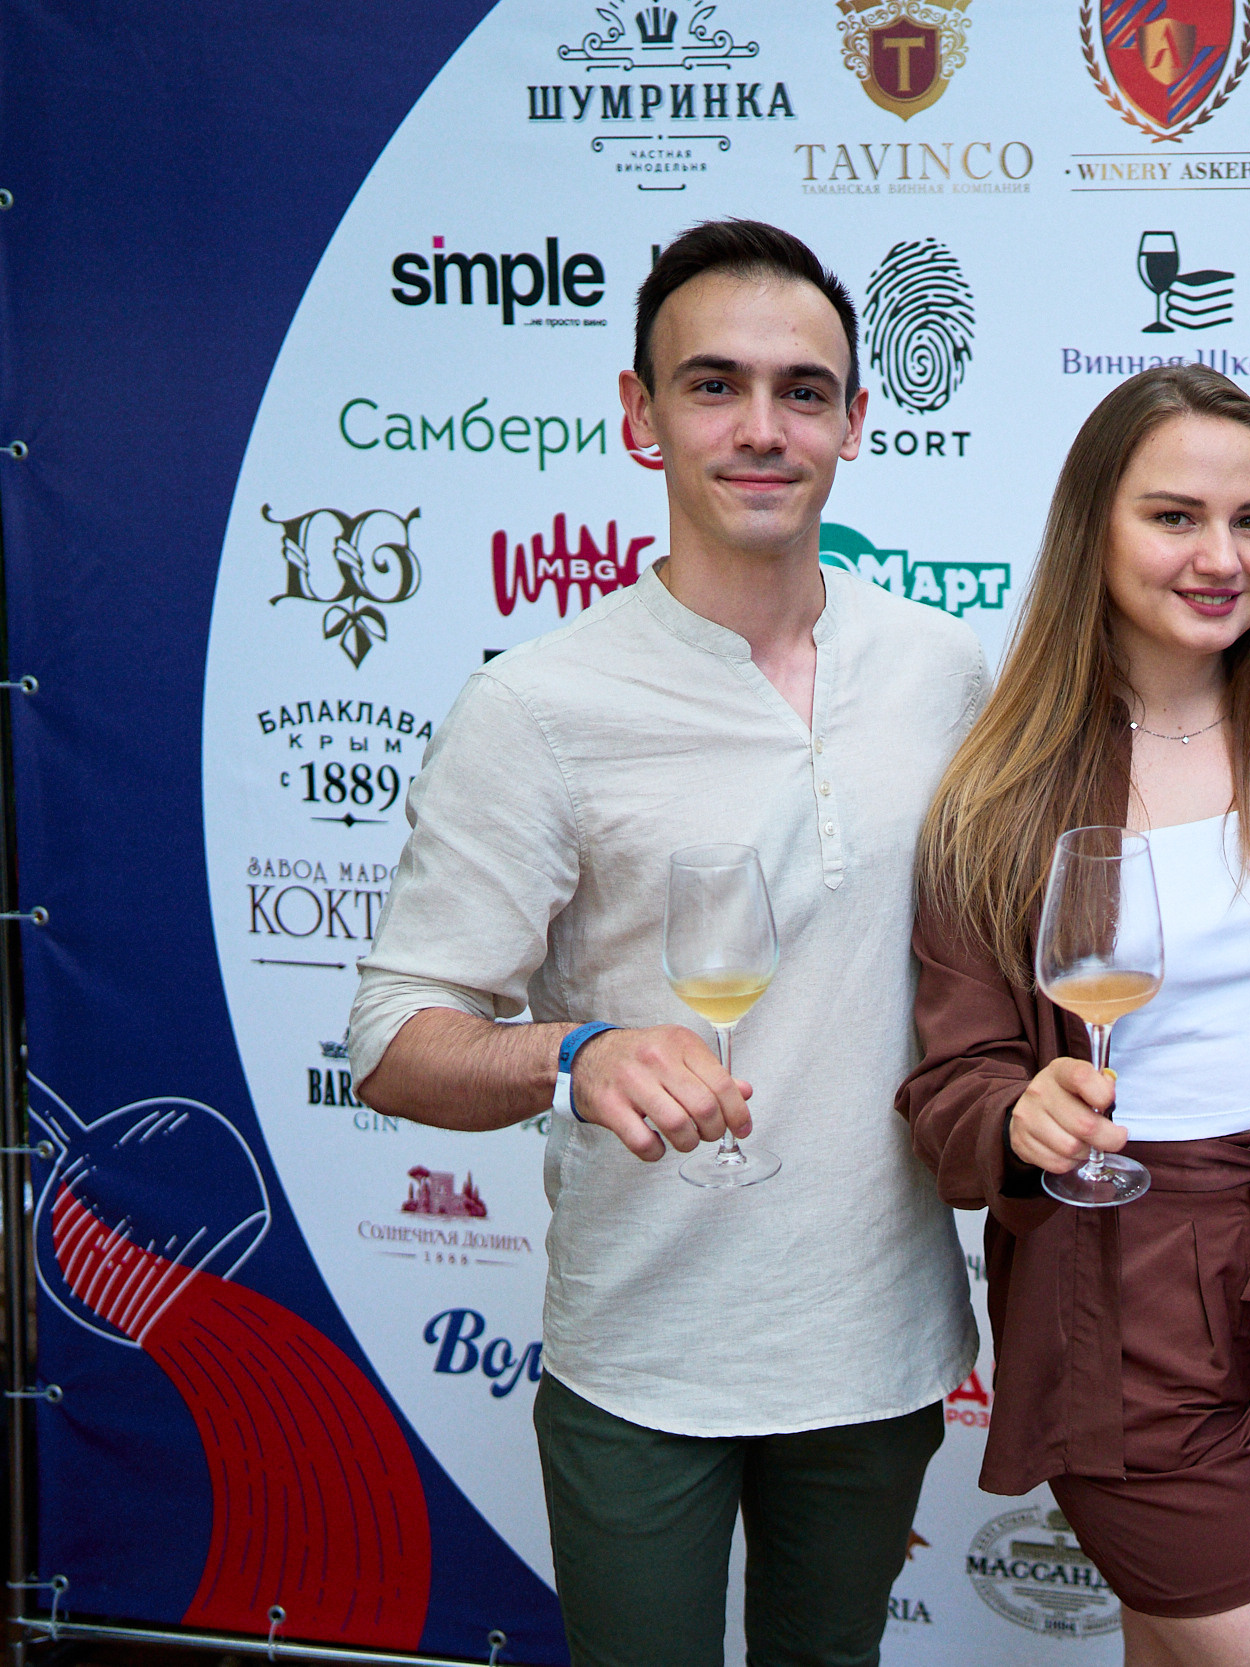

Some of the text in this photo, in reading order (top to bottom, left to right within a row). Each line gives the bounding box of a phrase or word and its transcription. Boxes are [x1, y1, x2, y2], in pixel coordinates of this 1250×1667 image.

[528, 82, 796, 122] ШУМРИНКА
[616, 162, 708, 173] ВИНОДЕЛЬНЯ
[630, 149, 693, 159] ЧАСТНАЯ
[795, 141, 1034, 180] TAVINCO
[1077, 162, 1171, 181] WINERY
[801, 183, 1031, 195] ТАМАНСКАЯ ВИННАЯ КОМПАНИЯ
[391, 236, 606, 326] simple
[340, 397, 607, 471] Самбери
[870, 430, 971, 457] SORT
[537, 558, 617, 580] MBG
[257, 699, 434, 742] БАЛАКЛАВА
[289, 733, 402, 753] КРЫМ
[300, 760, 400, 813] 1889
[247, 856, 328, 884] ЗАВОД
[247, 884, 388, 940] КОКТ
[308, 1067, 363, 1108] BAR
[424, 1307, 543, 1398] Вол
[966, 1554, 1115, 1594] МАССАНД
[888, 1595, 933, 1624] RIA
